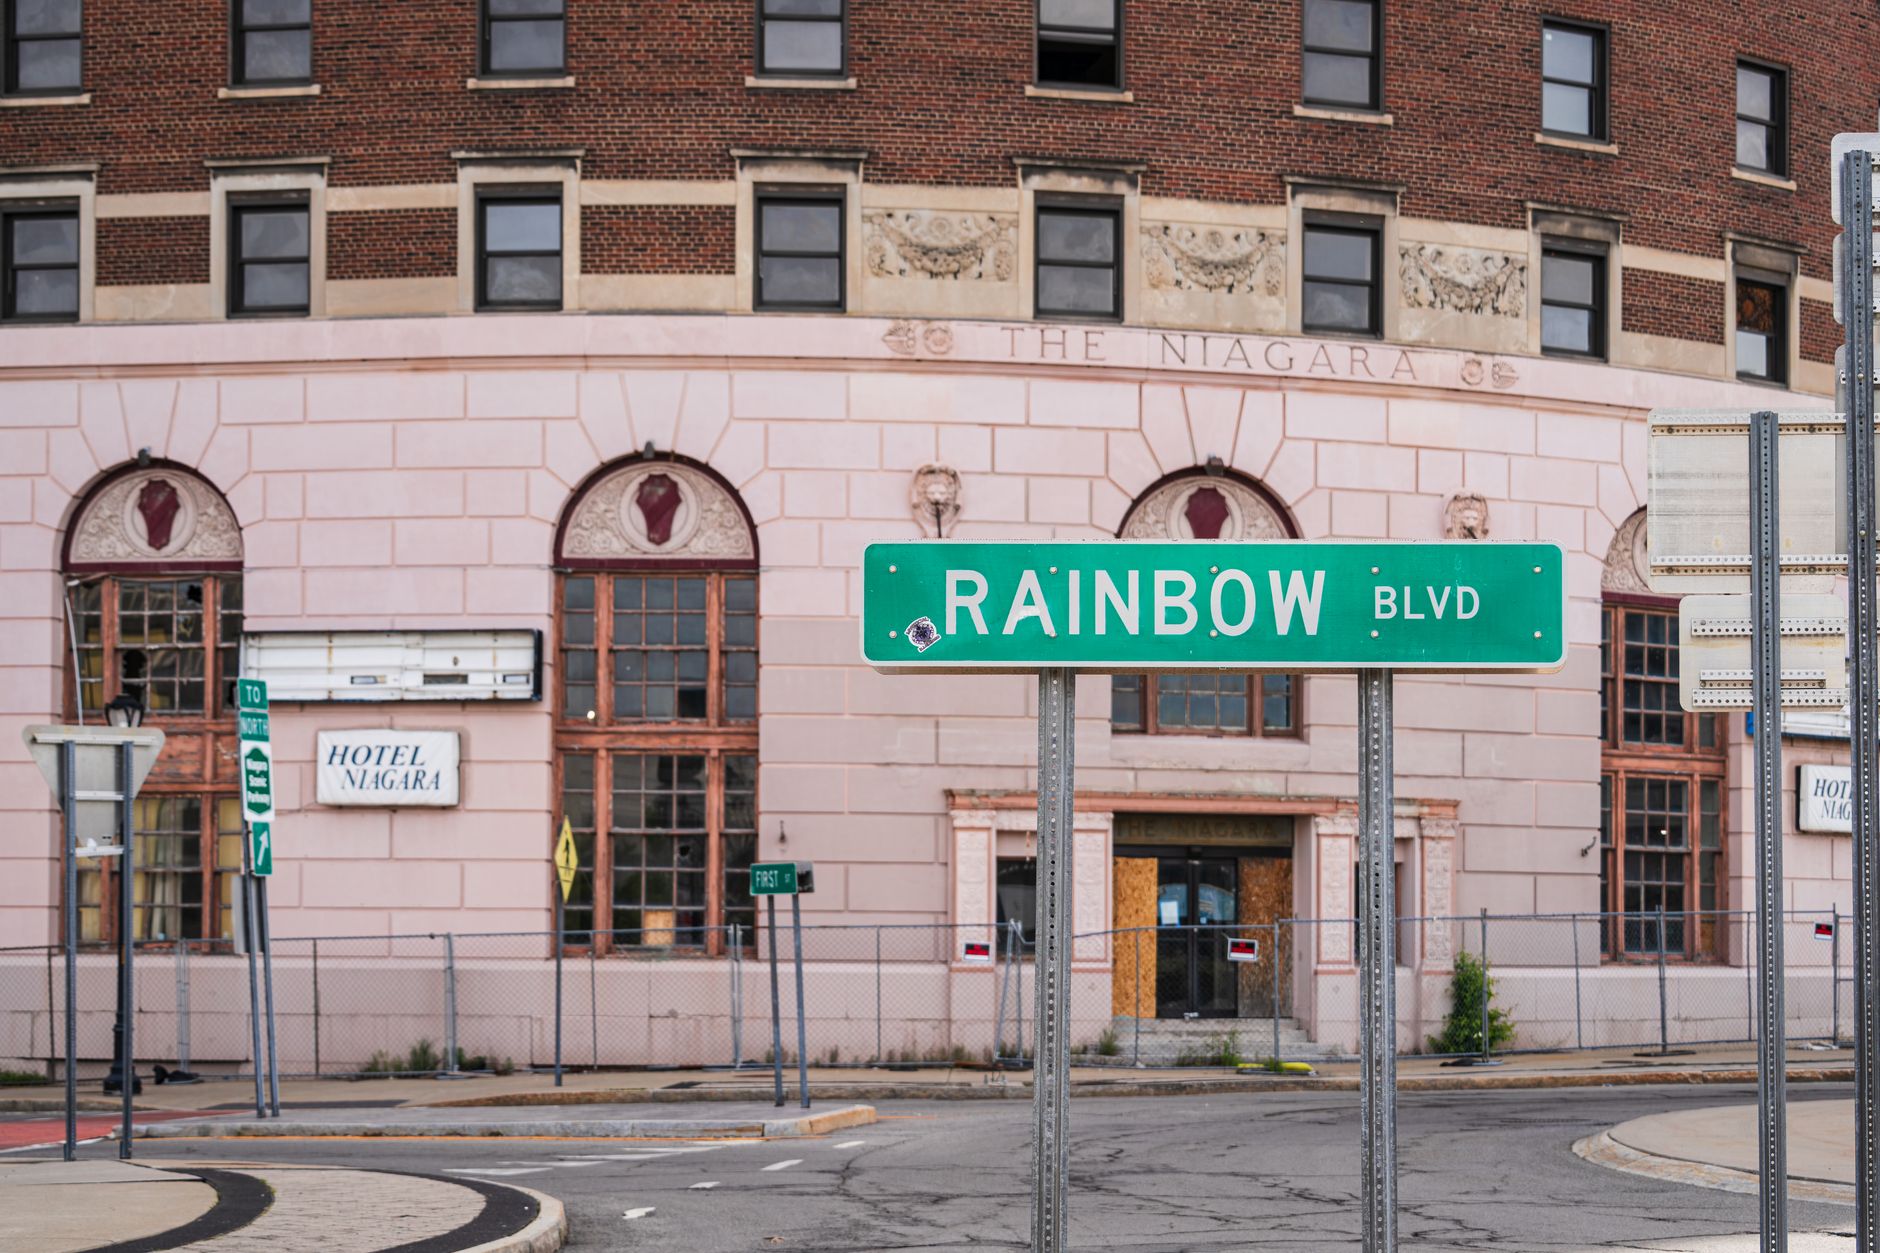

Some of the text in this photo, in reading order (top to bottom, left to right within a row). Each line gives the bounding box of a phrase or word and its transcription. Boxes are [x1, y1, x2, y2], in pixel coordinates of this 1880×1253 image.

[1000, 326, 1418, 381] THE NIAGARA
[945, 568, 1481, 637] RAINBOW BLVD
[245, 685, 261, 704] TO
[240, 717, 269, 736] NORTH
[327, 744, 426, 766] HOTEL
[341, 768, 440, 791] NIAGARA
[1813, 778, 1852, 799] HOT
[1821, 799, 1852, 821] NIAG
[756, 870, 779, 888] FIRST
